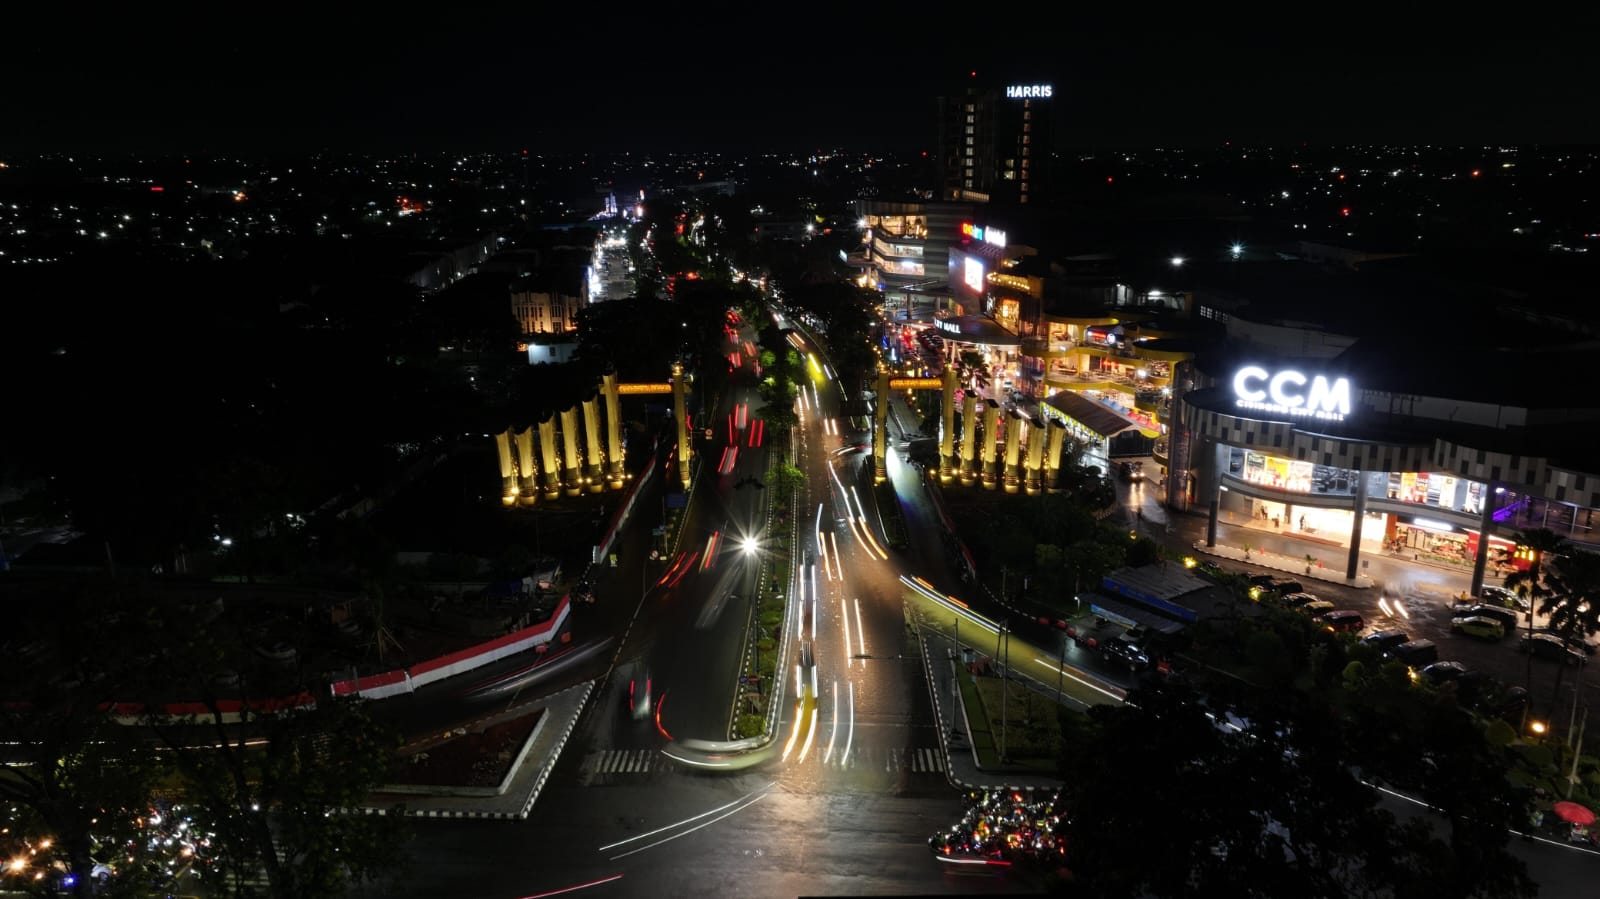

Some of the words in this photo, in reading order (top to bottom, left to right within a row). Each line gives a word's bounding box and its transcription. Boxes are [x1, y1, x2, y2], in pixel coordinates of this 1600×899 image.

[1006, 85, 1052, 98] HARRIS
[943, 322, 961, 334] MALL
[1234, 366, 1350, 414] CCM
